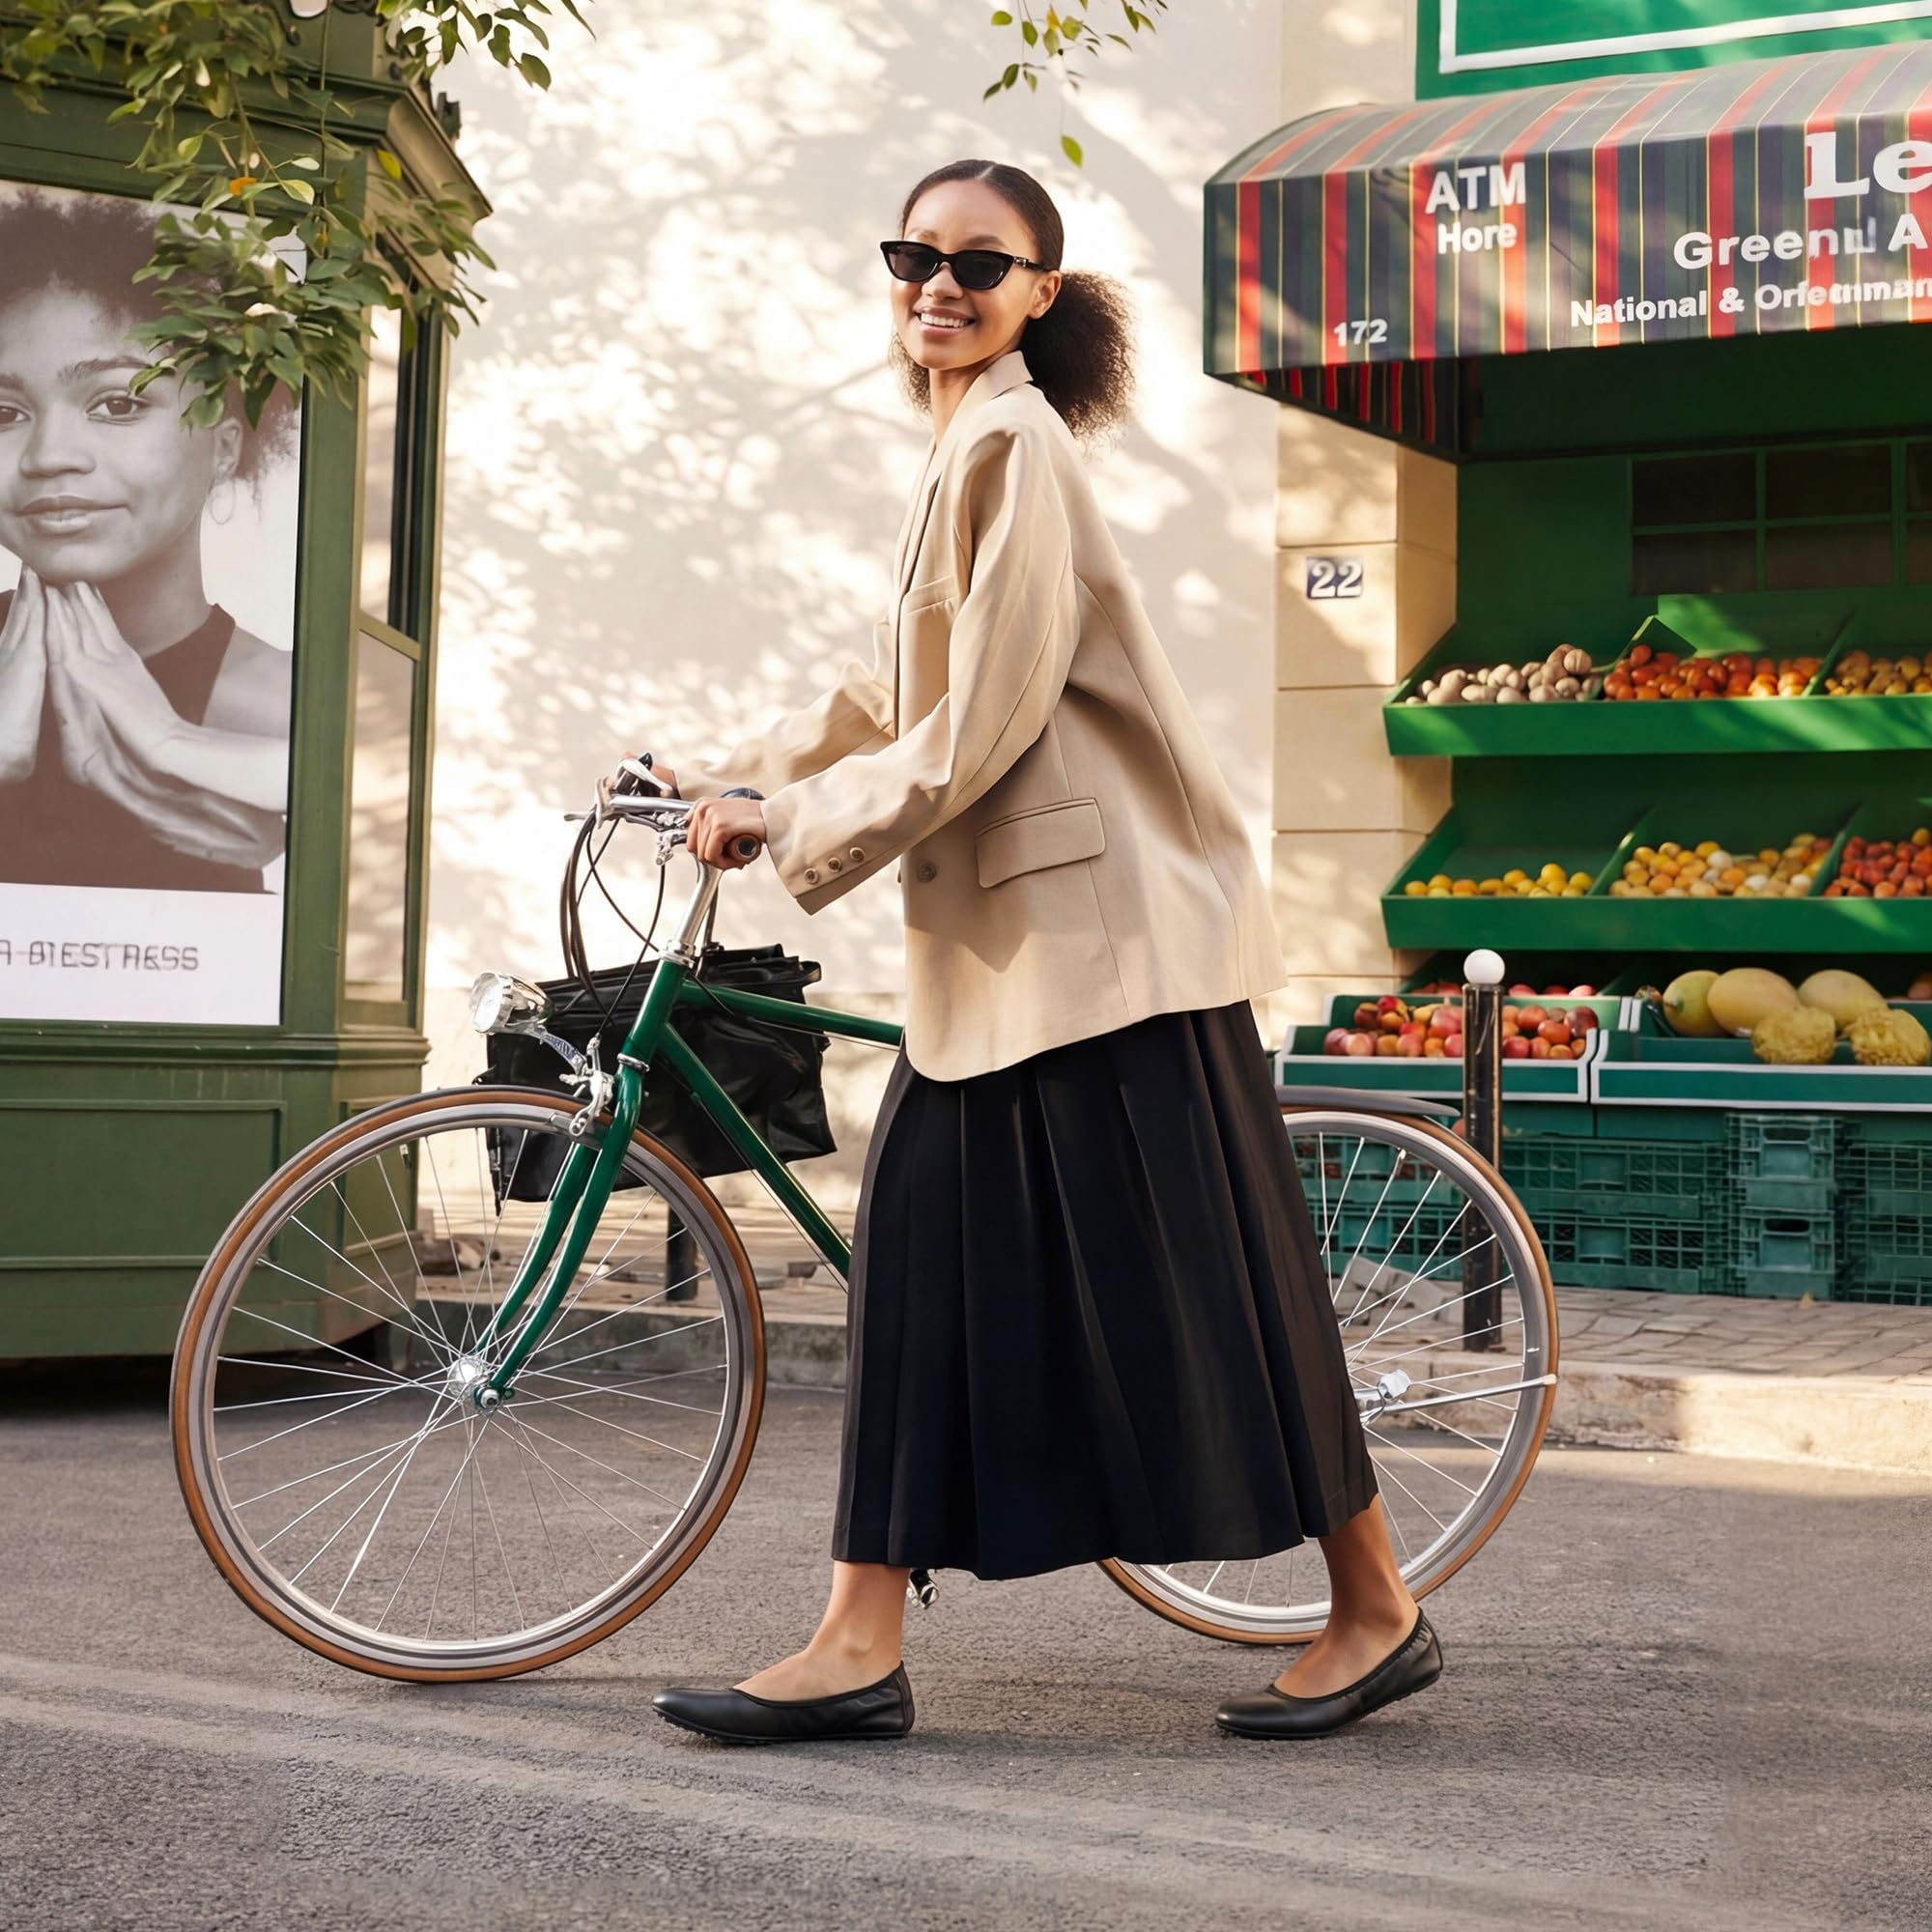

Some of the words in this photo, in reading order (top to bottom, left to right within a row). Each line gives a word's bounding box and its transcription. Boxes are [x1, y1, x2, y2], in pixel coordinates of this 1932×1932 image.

[1425, 162, 1526, 214] ATM
[1437, 221, 1518, 255] Hore
[1888, 213, 1928, 252] A
[1571, 291, 1707, 327] National
[1719, 287, 1745, 314] &
[1333, 318, 1388, 347] 172
[1311, 559, 1361, 598] 22
